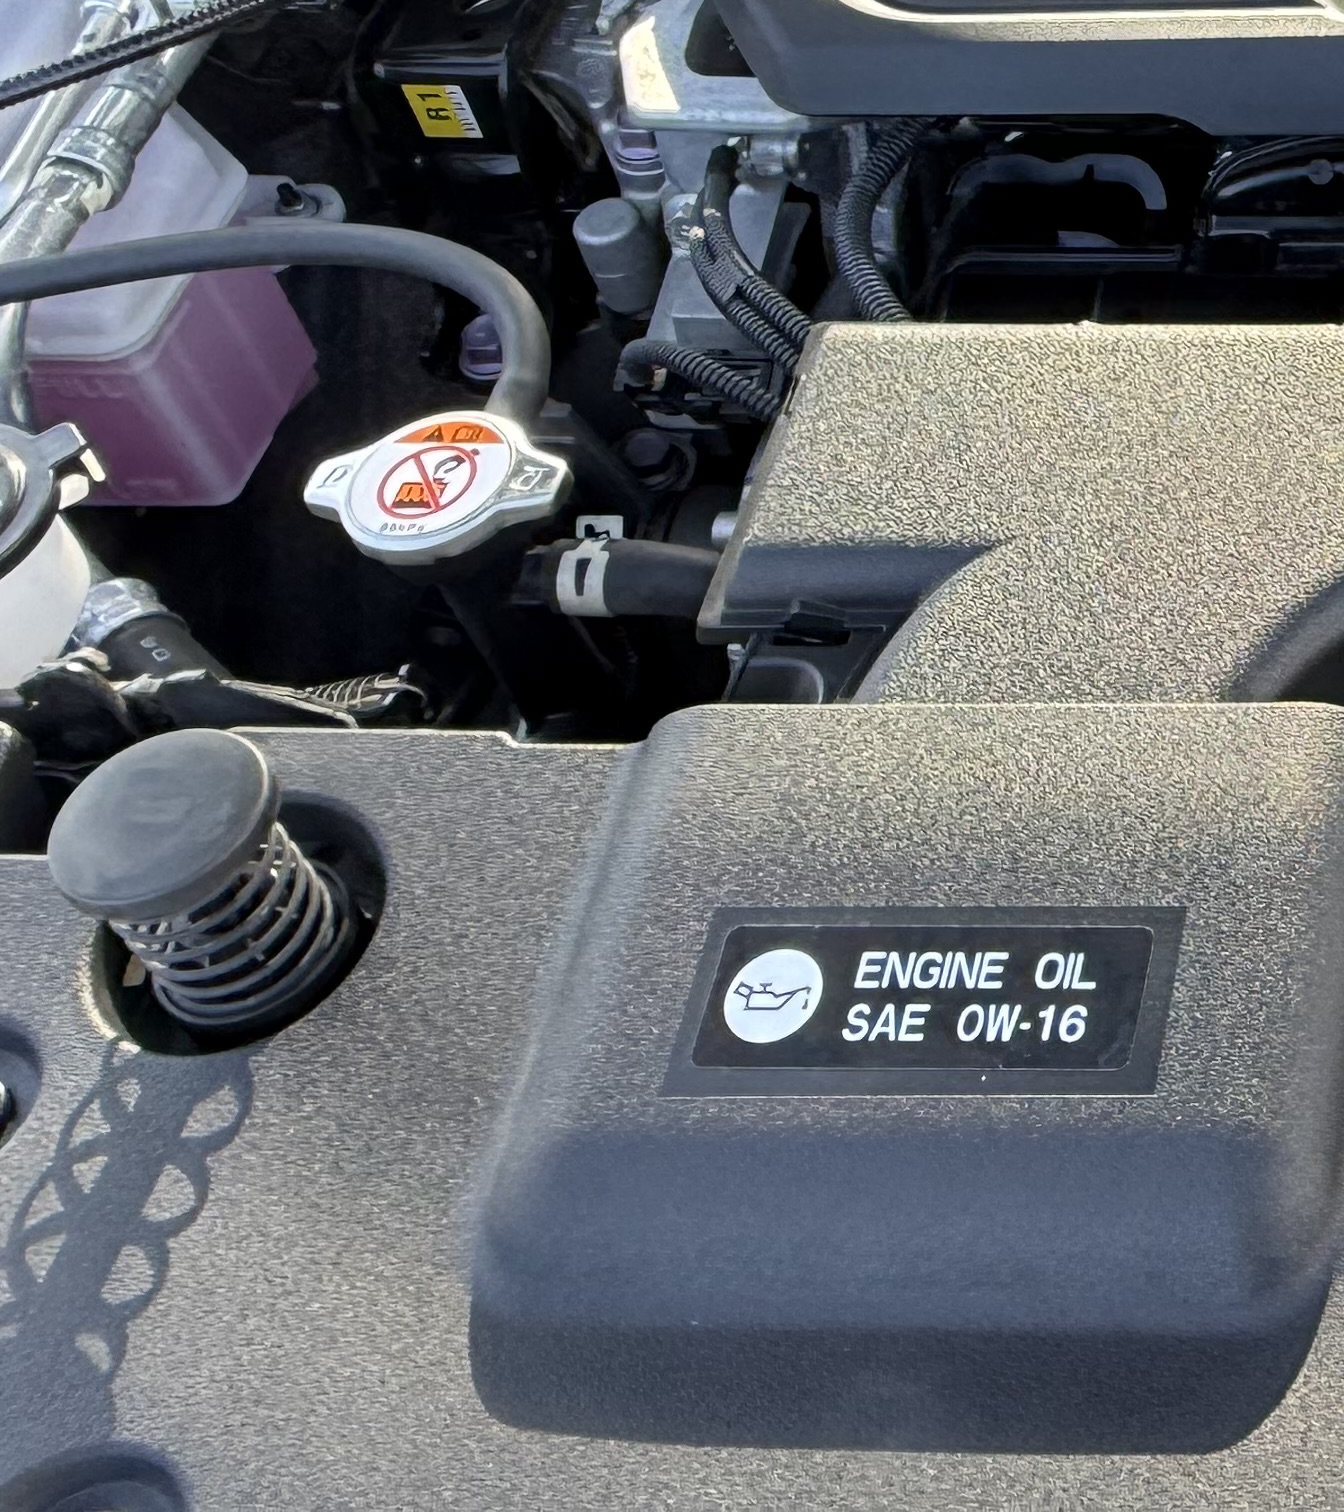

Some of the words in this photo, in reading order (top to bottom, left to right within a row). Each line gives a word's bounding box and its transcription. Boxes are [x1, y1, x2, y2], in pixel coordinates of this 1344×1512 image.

[853, 950, 1010, 990] ENGINE
[1034, 951, 1098, 990] OIL
[841, 1003, 932, 1042] SAE
[956, 1003, 1090, 1043] 0W-16
